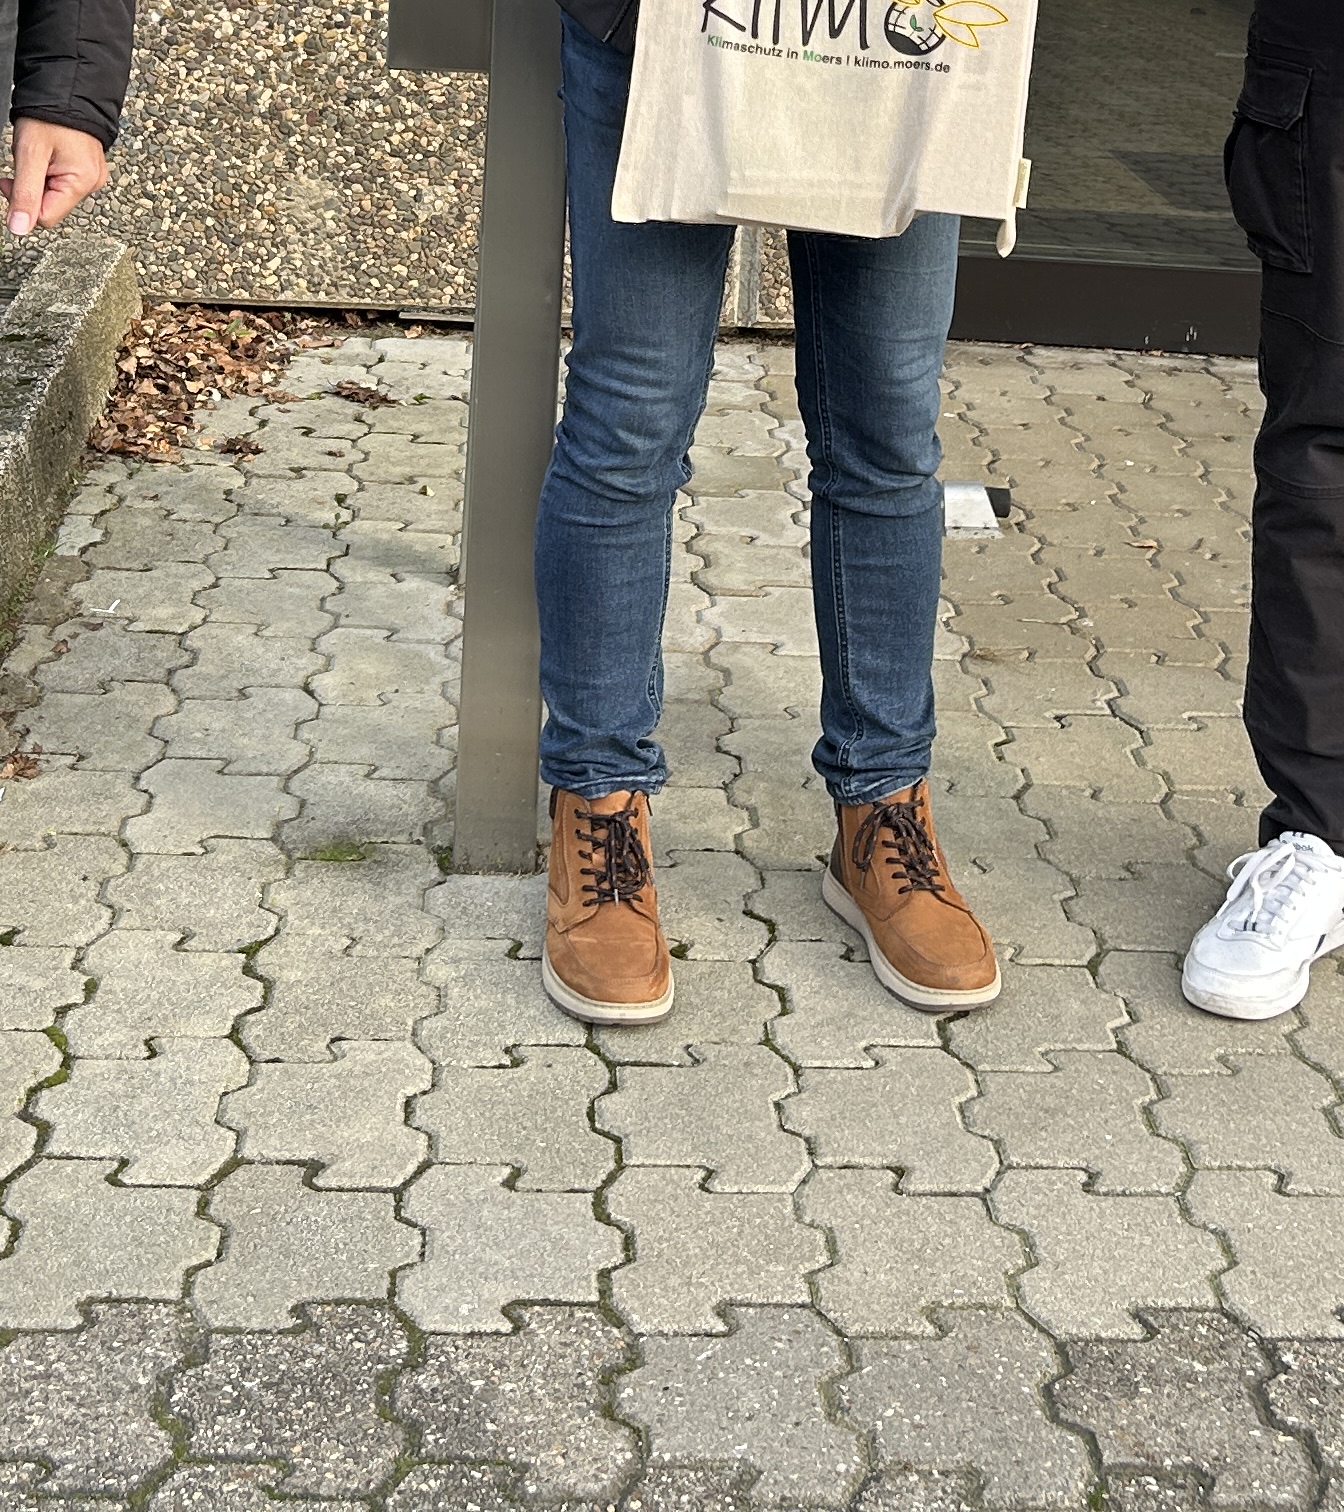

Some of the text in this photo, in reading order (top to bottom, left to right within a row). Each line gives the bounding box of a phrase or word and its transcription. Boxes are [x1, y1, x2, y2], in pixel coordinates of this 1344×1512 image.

[707, 34, 783, 58] Klimaschutz
[786, 47, 799, 60] in
[803, 49, 842, 66] Moers
[854, 54, 951, 74] klimo.moers.de
